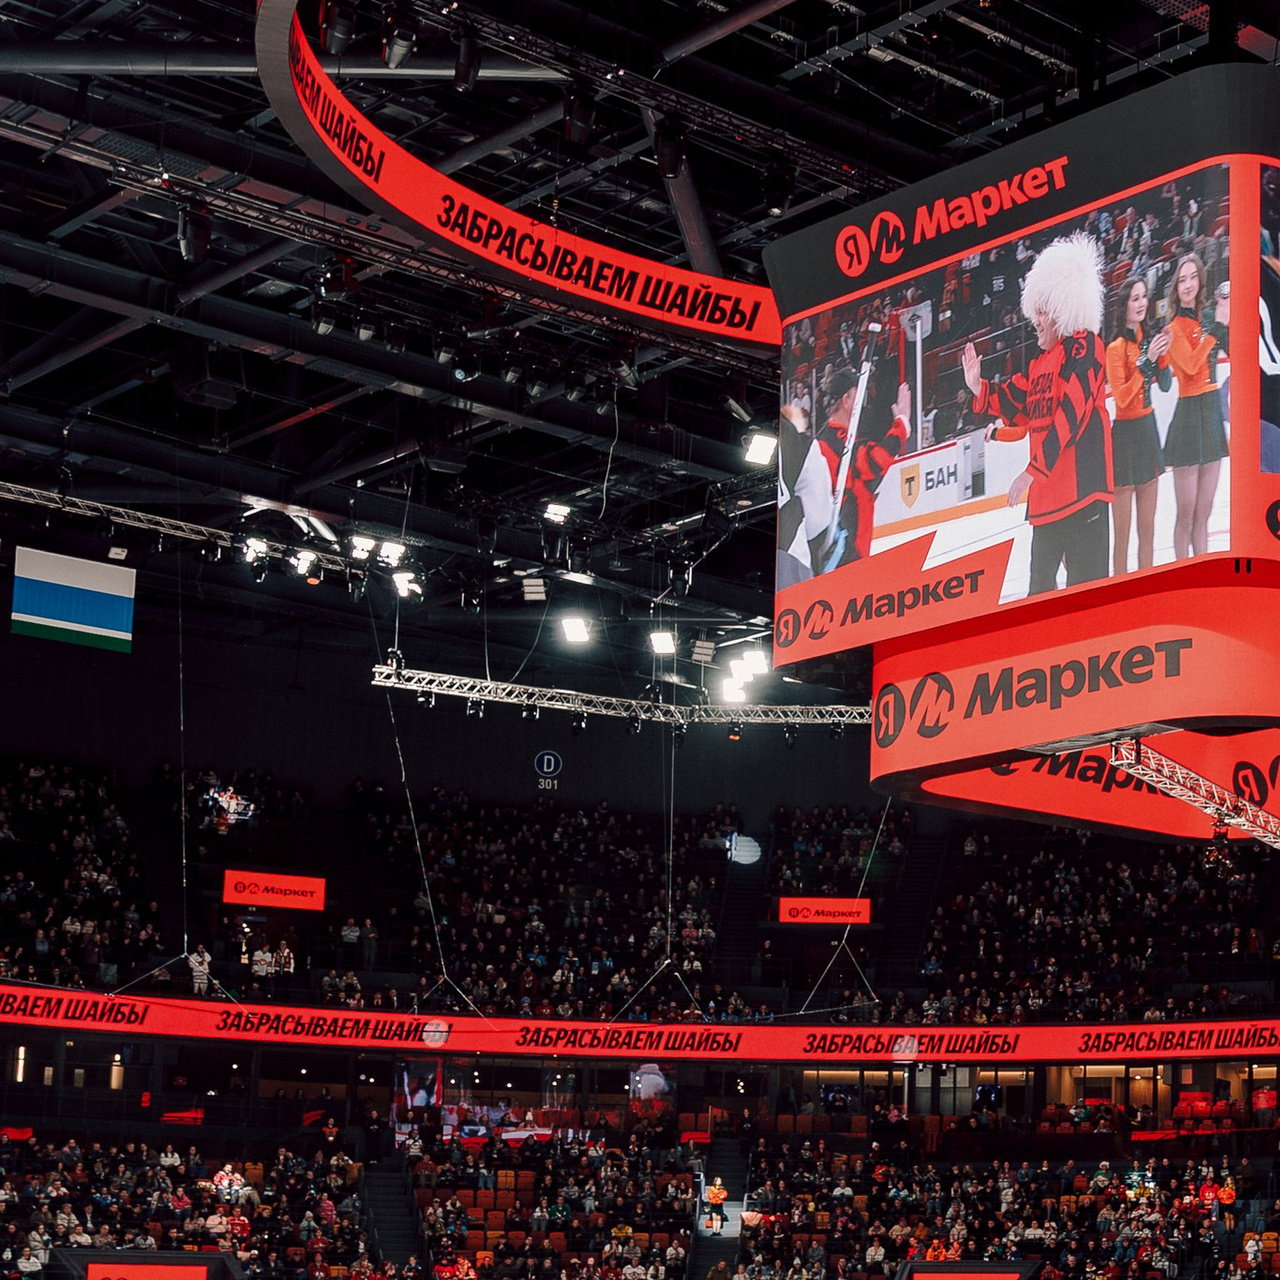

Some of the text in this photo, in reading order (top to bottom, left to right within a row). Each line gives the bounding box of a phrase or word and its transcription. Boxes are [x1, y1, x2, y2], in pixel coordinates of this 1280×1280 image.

[319, 95, 386, 185] ШАЙБЫ
[913, 156, 1069, 245] Маркет
[437, 194, 762, 333] ЗАБРАСЫВАЕМ ШАЙБЫ
[840, 570, 985, 628] Маркет
[963, 638, 1193, 720] Маркет
[542, 756, 554, 772] D
[538, 778, 558, 790] 301
[262, 885, 316, 899] Маркет
[812, 907, 863, 919] Маркет
[63, 997, 150, 1025] ШАЙБЫ
[215, 1011, 370, 1040] ЗАБРАСЫВАЕМ
[515, 1026, 742, 1053] ЗАБРАСЫВАЕМ ШАЙБЫ
[803, 1030, 1020, 1055] ЗАБРАСЫВАЕМ ШАЙБЫ
[1078, 1029, 1214, 1053] ЗАБРАСЫВАЕМ
